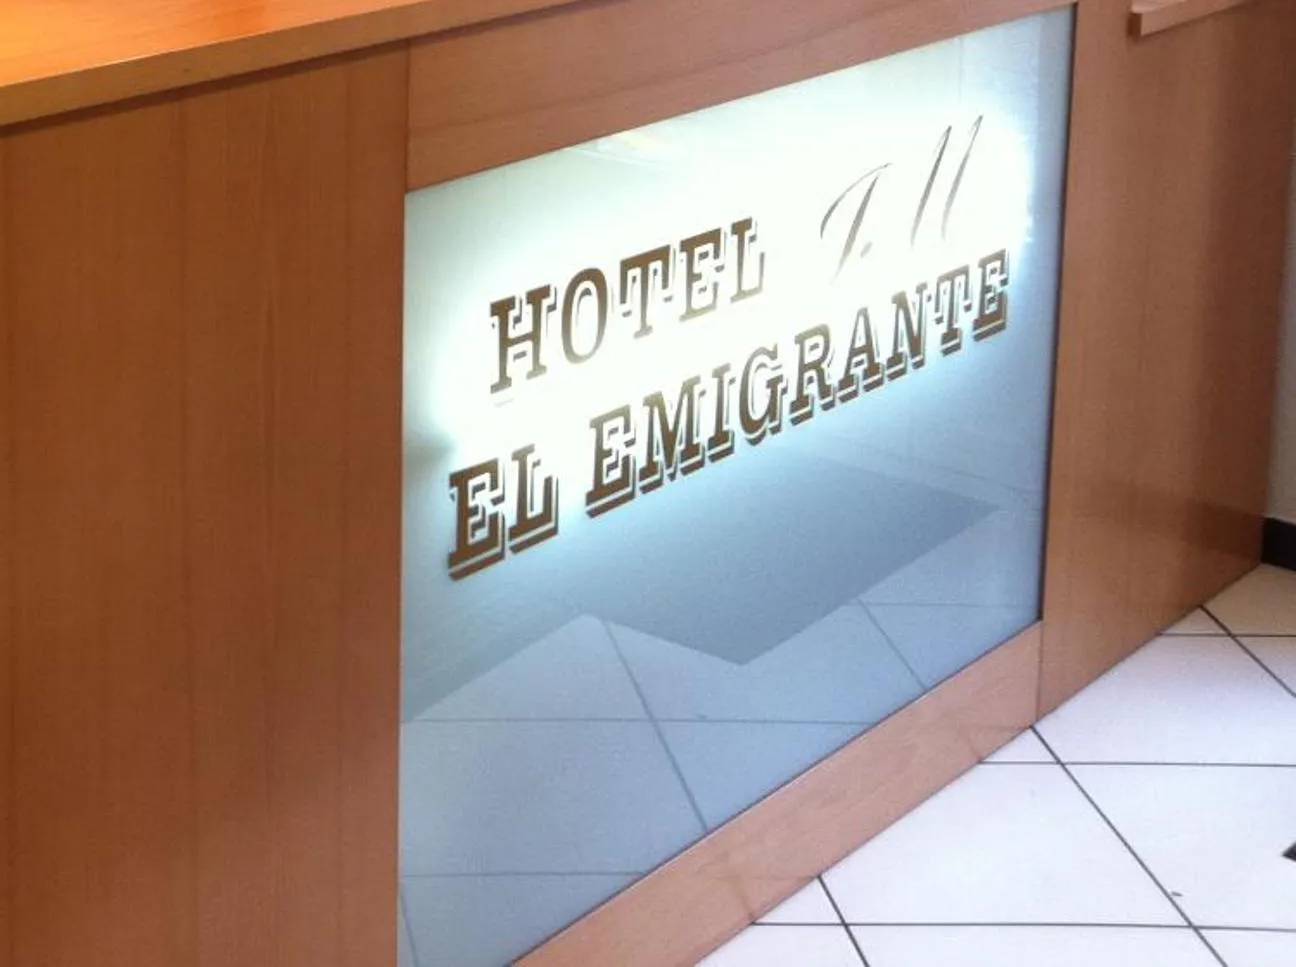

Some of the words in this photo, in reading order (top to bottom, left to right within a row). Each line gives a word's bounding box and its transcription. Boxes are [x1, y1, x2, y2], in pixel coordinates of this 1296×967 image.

[448, 444, 558, 580] EL
[586, 249, 1008, 517] EMIGRANTE
[490, 217, 766, 393] HOTEL
